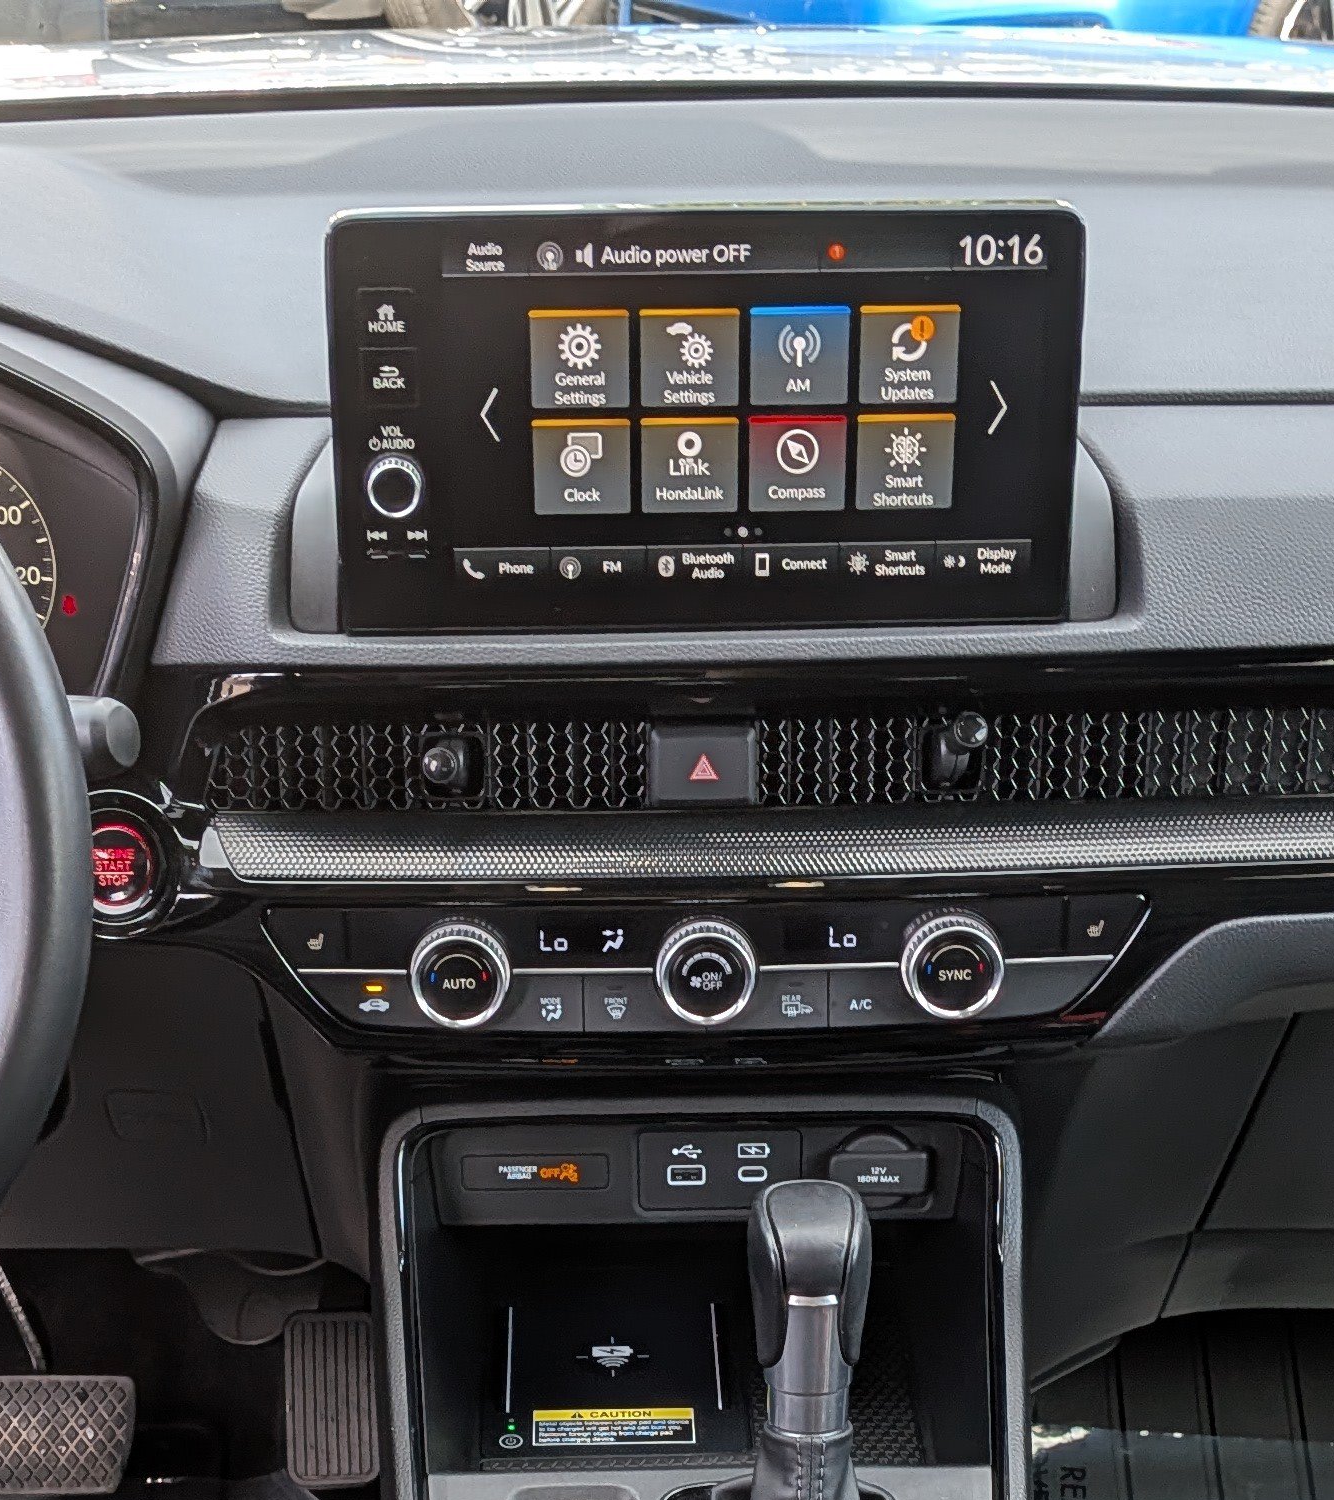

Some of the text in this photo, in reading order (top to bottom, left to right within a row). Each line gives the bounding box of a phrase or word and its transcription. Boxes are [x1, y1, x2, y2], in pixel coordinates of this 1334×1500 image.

[467, 242, 503, 256] Audio
[601, 244, 752, 267] Audio power OFF
[959, 234, 1044, 266] 10:16
[466, 259, 505, 272] Source
[368, 321, 406, 333] HOME
[555, 371, 606, 386] General
[666, 370, 713, 385] Vehicle
[884, 367, 931, 383] System
[373, 377, 405, 389] BACK
[785, 378, 811, 393] AM
[554, 390, 607, 407] Settings
[663, 389, 716, 406] Settings
[880, 386, 935, 402] Updates
[381, 426, 404, 437] VOL
[381, 438, 415, 450] AUDIO
[885, 474, 923, 489] Smart
[564, 487, 600, 502] Clock
[655, 487, 724, 501] HondaLink
[768, 486, 826, 501] Compass
[873, 492, 934, 507] Shortcuts
[682, 551, 735, 566] Bluetooth
[885, 549, 916, 562] Smart
[977, 547, 1017, 562] Display
[498, 562, 534, 575] Phone
[602, 561, 622, 573] FM
[782, 558, 827, 571] Connect
[875, 563, 926, 577] Shortcuts
[980, 561, 1012, 575] Mode
[16, 566, 41, 585] 20
[692, 566, 725, 580] Audio
[95, 860, 132, 872] START
[98, 874, 129, 887] STOP
[938, 969, 972, 982] SYNC
[442, 978, 476, 990] AUTO
[702, 981, 723, 991] OFF
[540, 997, 562, 1005] MODE
[604, 997, 627, 1005] FRONT
[849, 999, 872, 1011] A/C
[498, 1165, 538, 1173] PASSENGER
[539, 1167, 561, 1179] OFF
[870, 1166, 887, 1175] 12V
[879, 1175, 900, 1183] MAX
[589, 1410, 652, 1418] CAUTION
